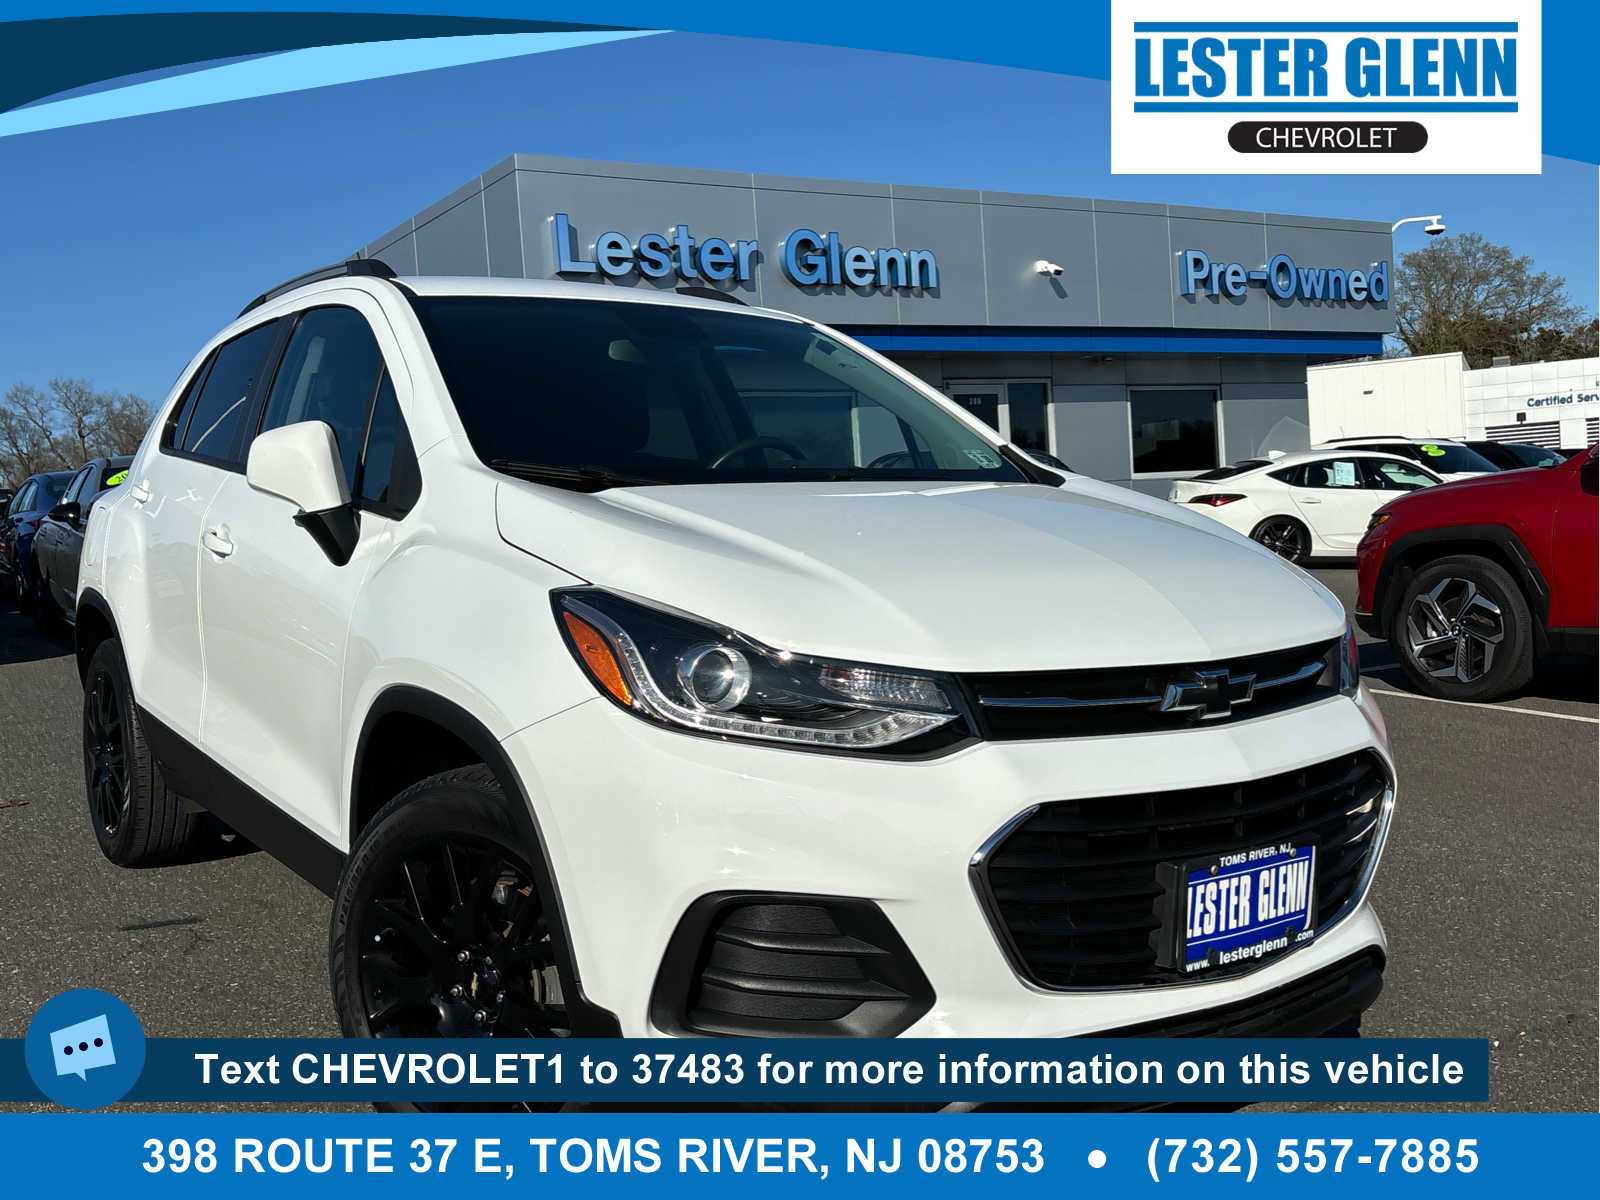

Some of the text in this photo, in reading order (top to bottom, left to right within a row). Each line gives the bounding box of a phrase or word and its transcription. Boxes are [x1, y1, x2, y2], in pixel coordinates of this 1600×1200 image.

[553, 213, 938, 290] Lester Glenn
[1180, 248, 1390, 303] Pre-Owned
[1527, 394, 1573, 407] Certified
[1219, 852, 1247, 868] TOMS
[1186, 860, 1309, 939] LESTER GLENN
[1185, 929, 1315, 973] www. lesterglenn .com
